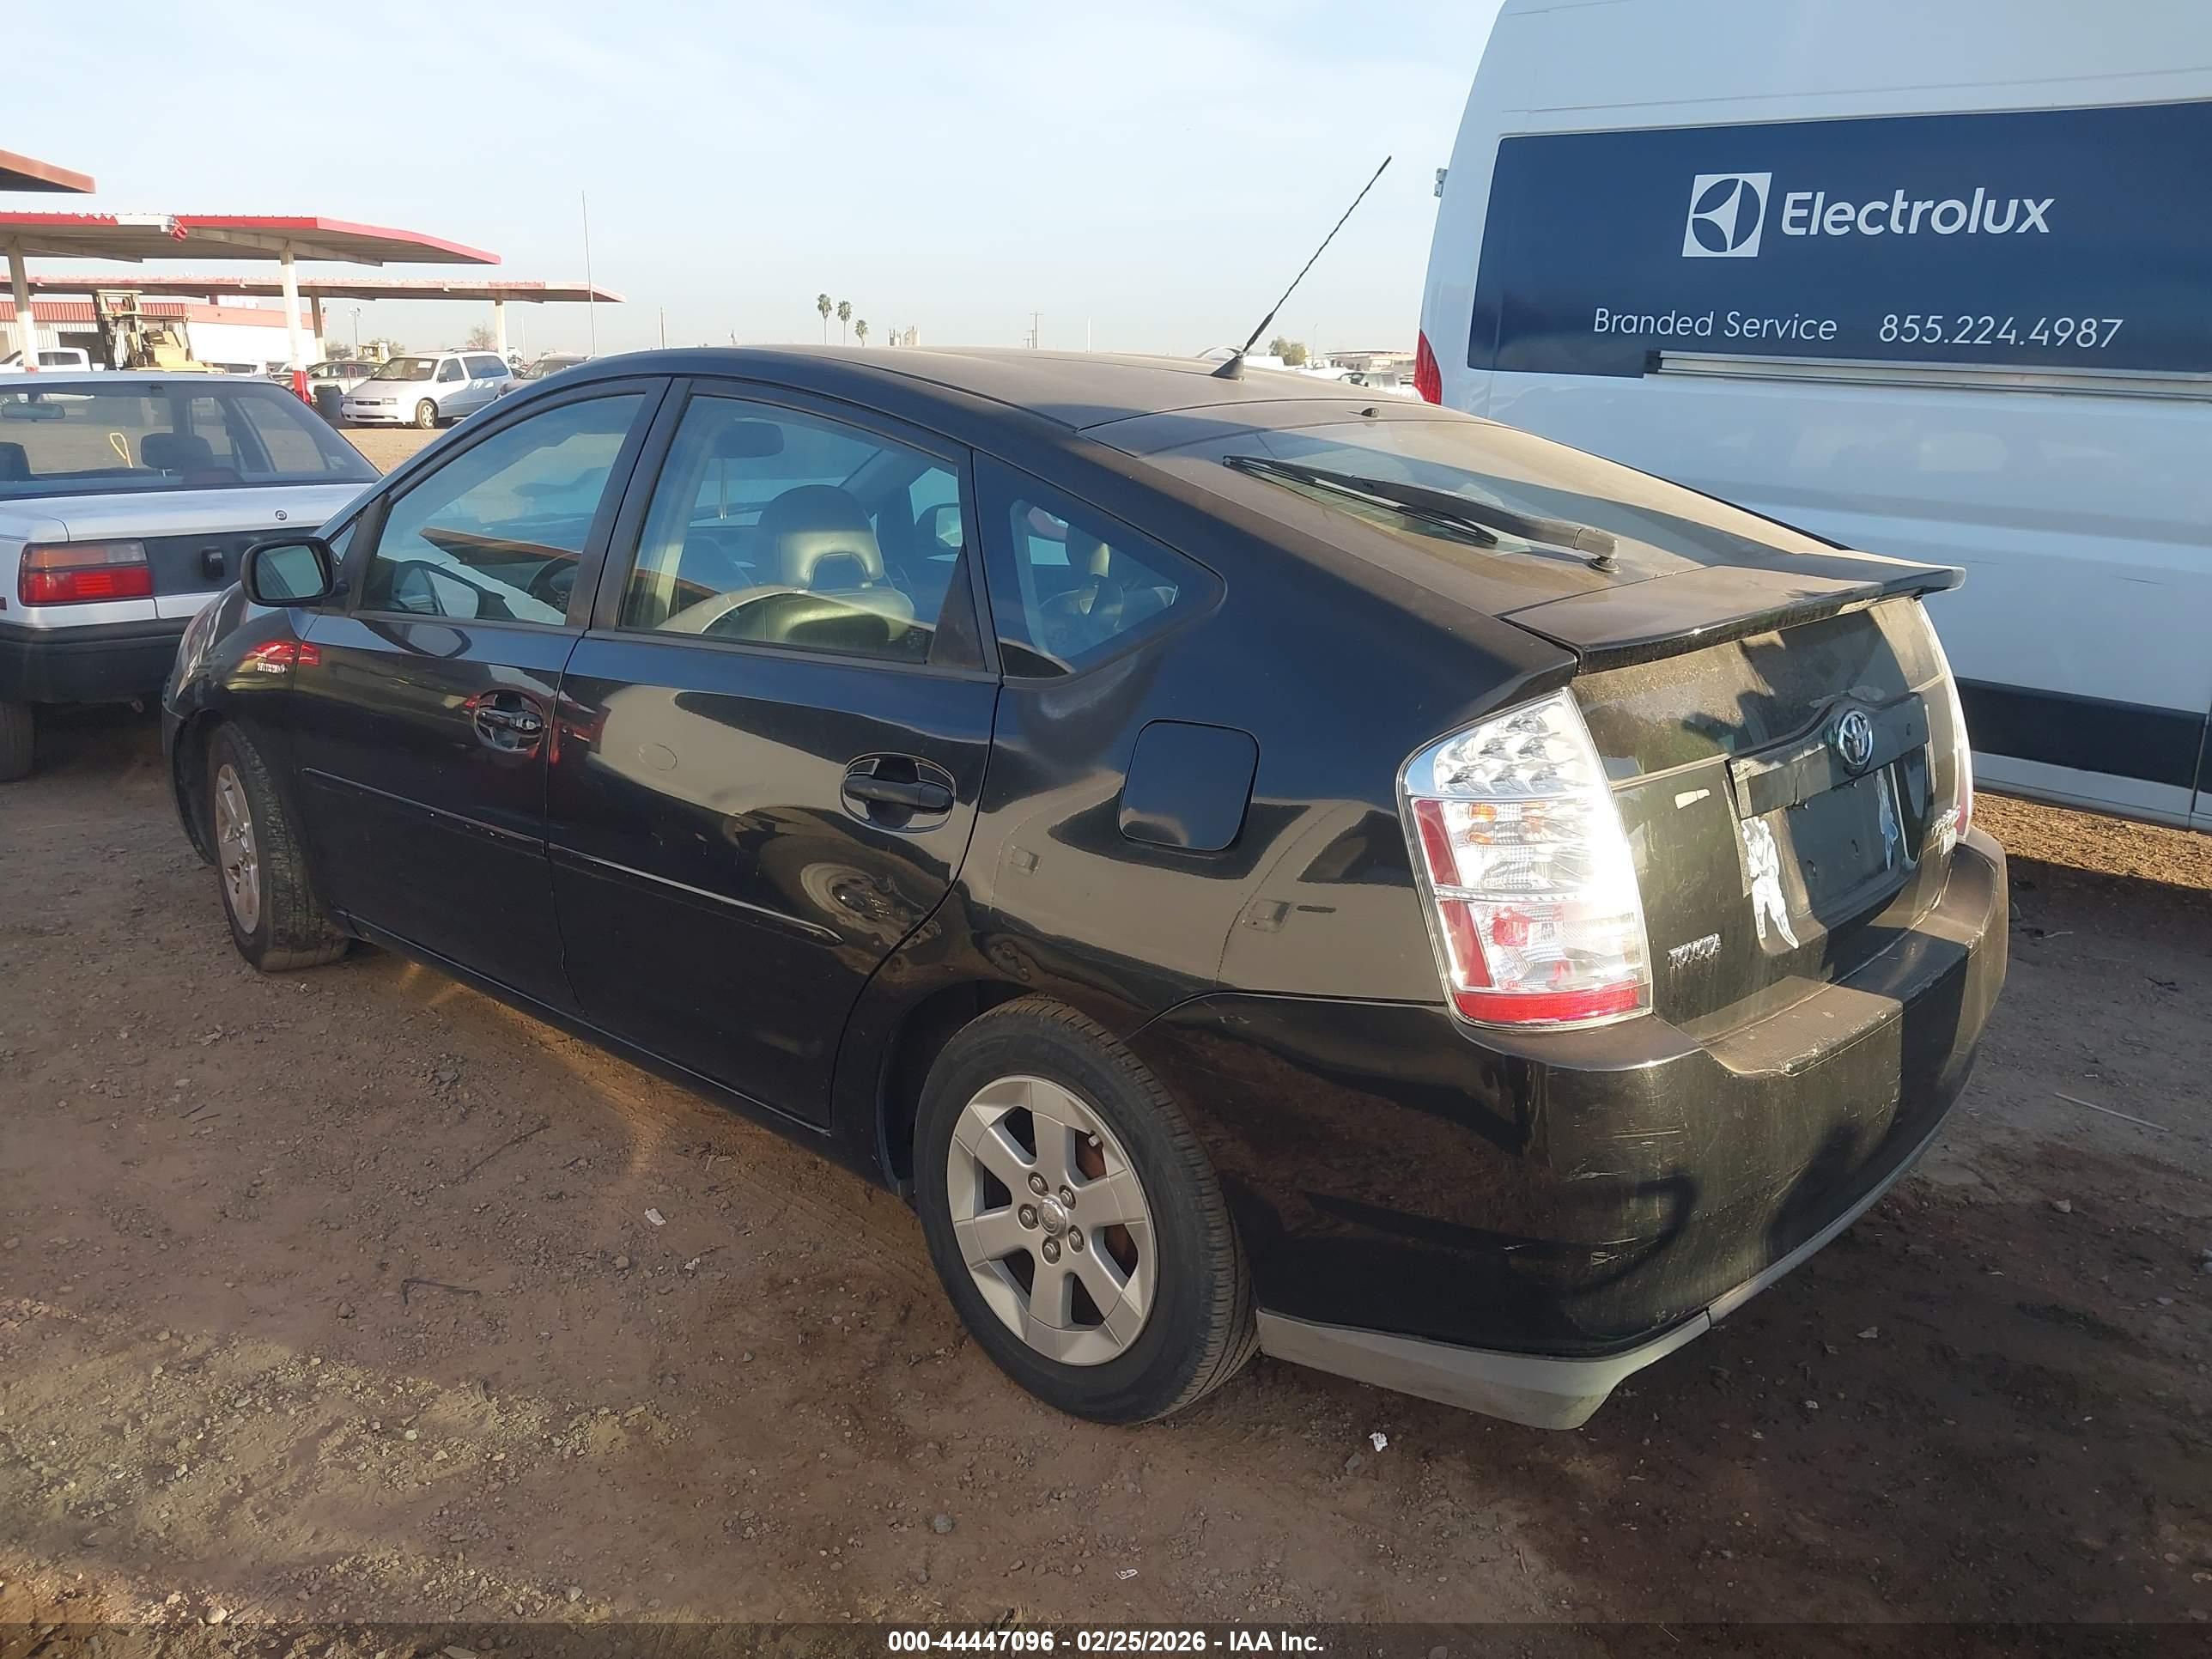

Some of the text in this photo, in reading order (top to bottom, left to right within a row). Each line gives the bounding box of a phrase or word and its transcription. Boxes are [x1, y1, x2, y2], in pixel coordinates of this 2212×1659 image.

[1781, 186, 2056, 237] Electrolux
[1593, 307, 1838, 341] Branded Service
[1878, 314, 2124, 349] 855.224.4987
